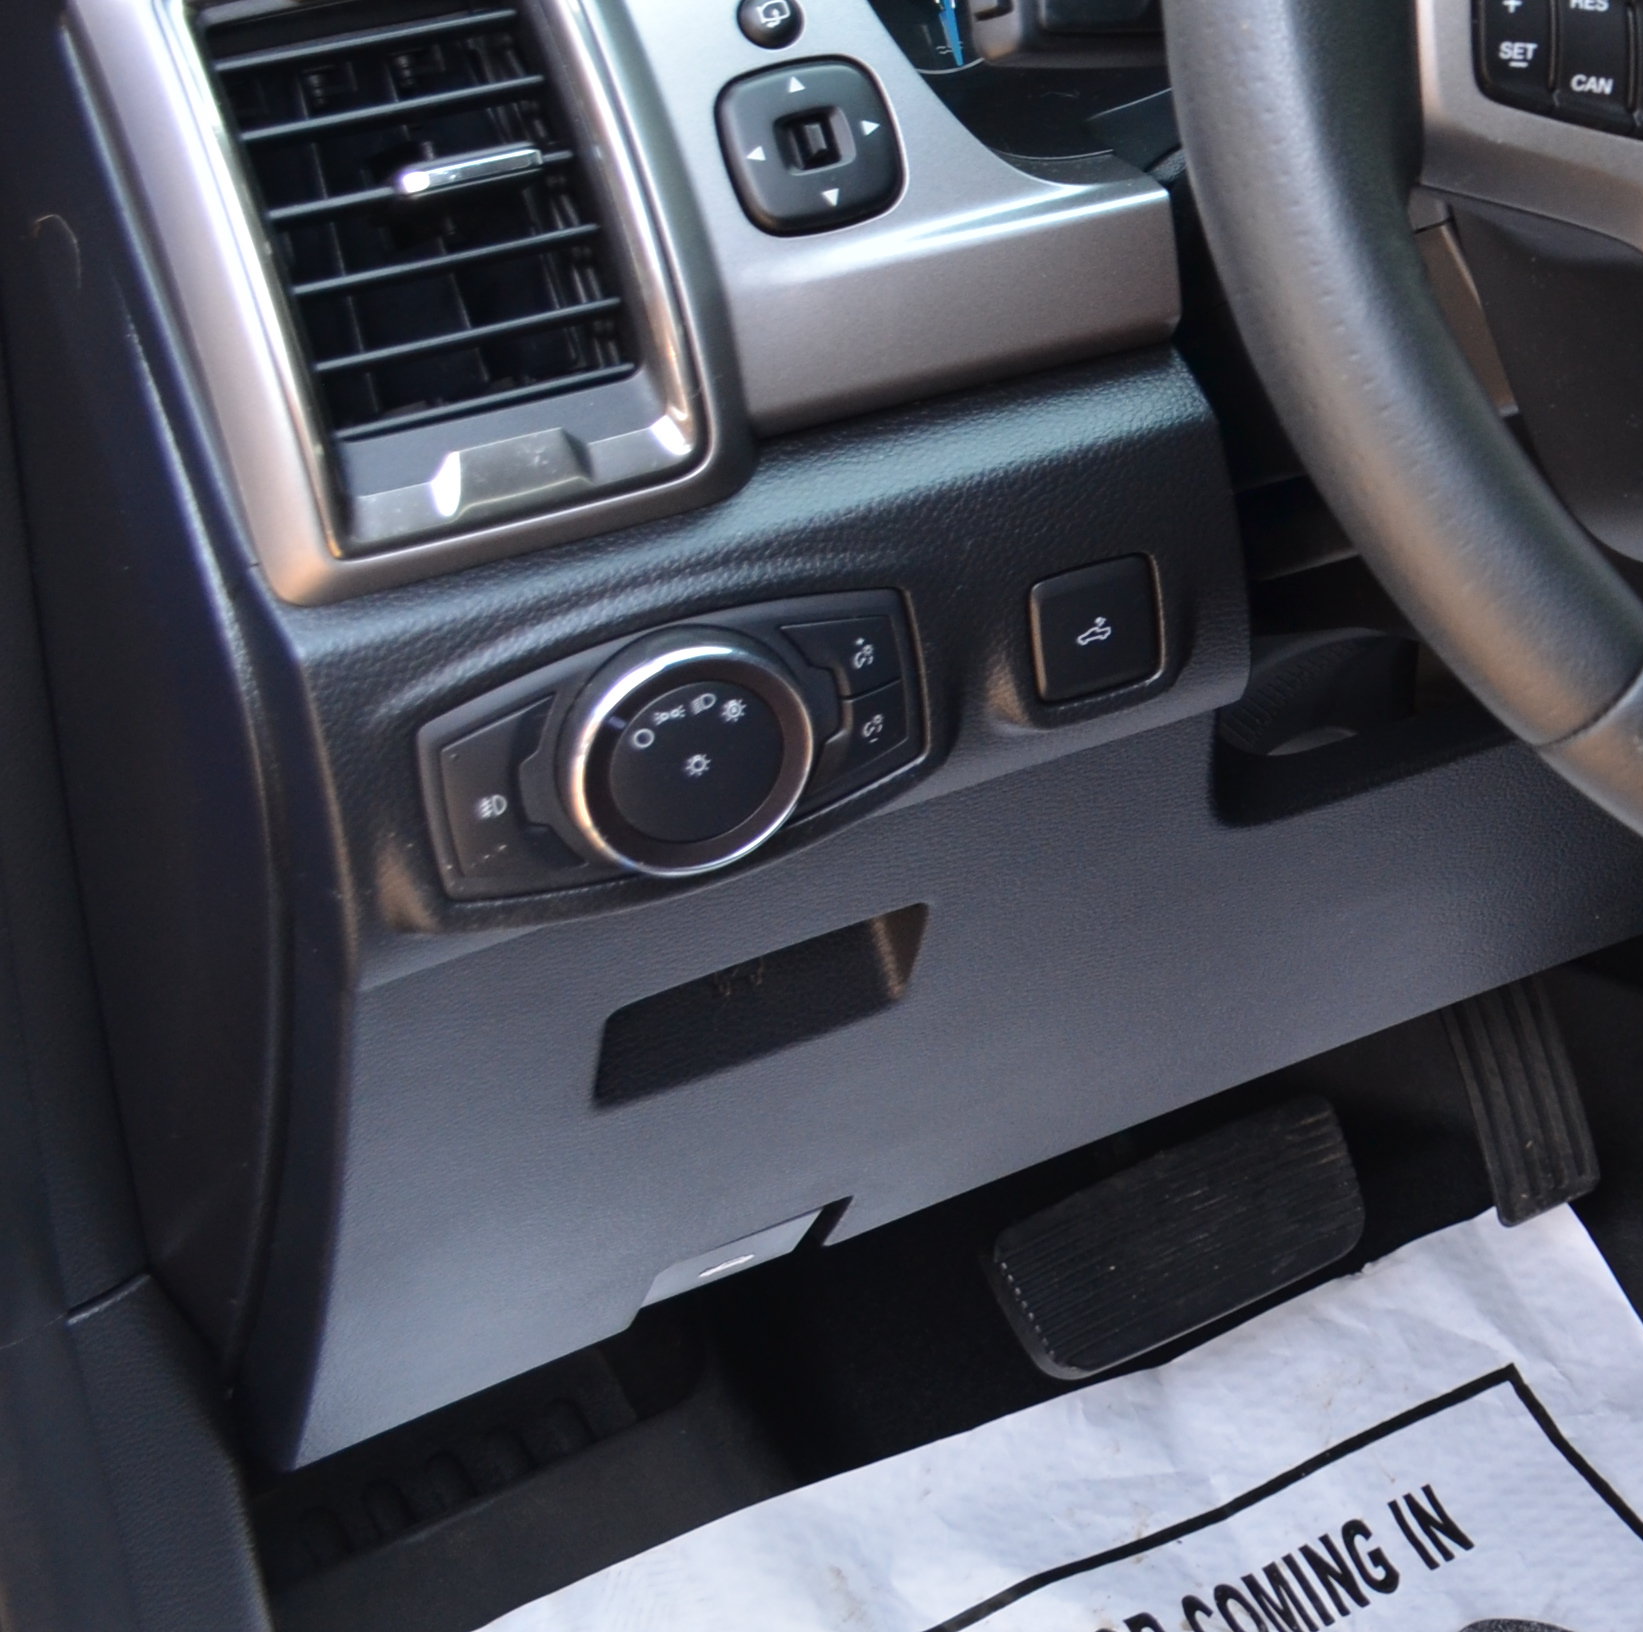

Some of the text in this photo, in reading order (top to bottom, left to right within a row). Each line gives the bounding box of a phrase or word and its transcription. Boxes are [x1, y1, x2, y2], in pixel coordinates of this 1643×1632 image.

[1499, 42, 1538, 61] SET
[1571, 74, 1613, 95] CAN
[1387, 1483, 1475, 1570] IN
